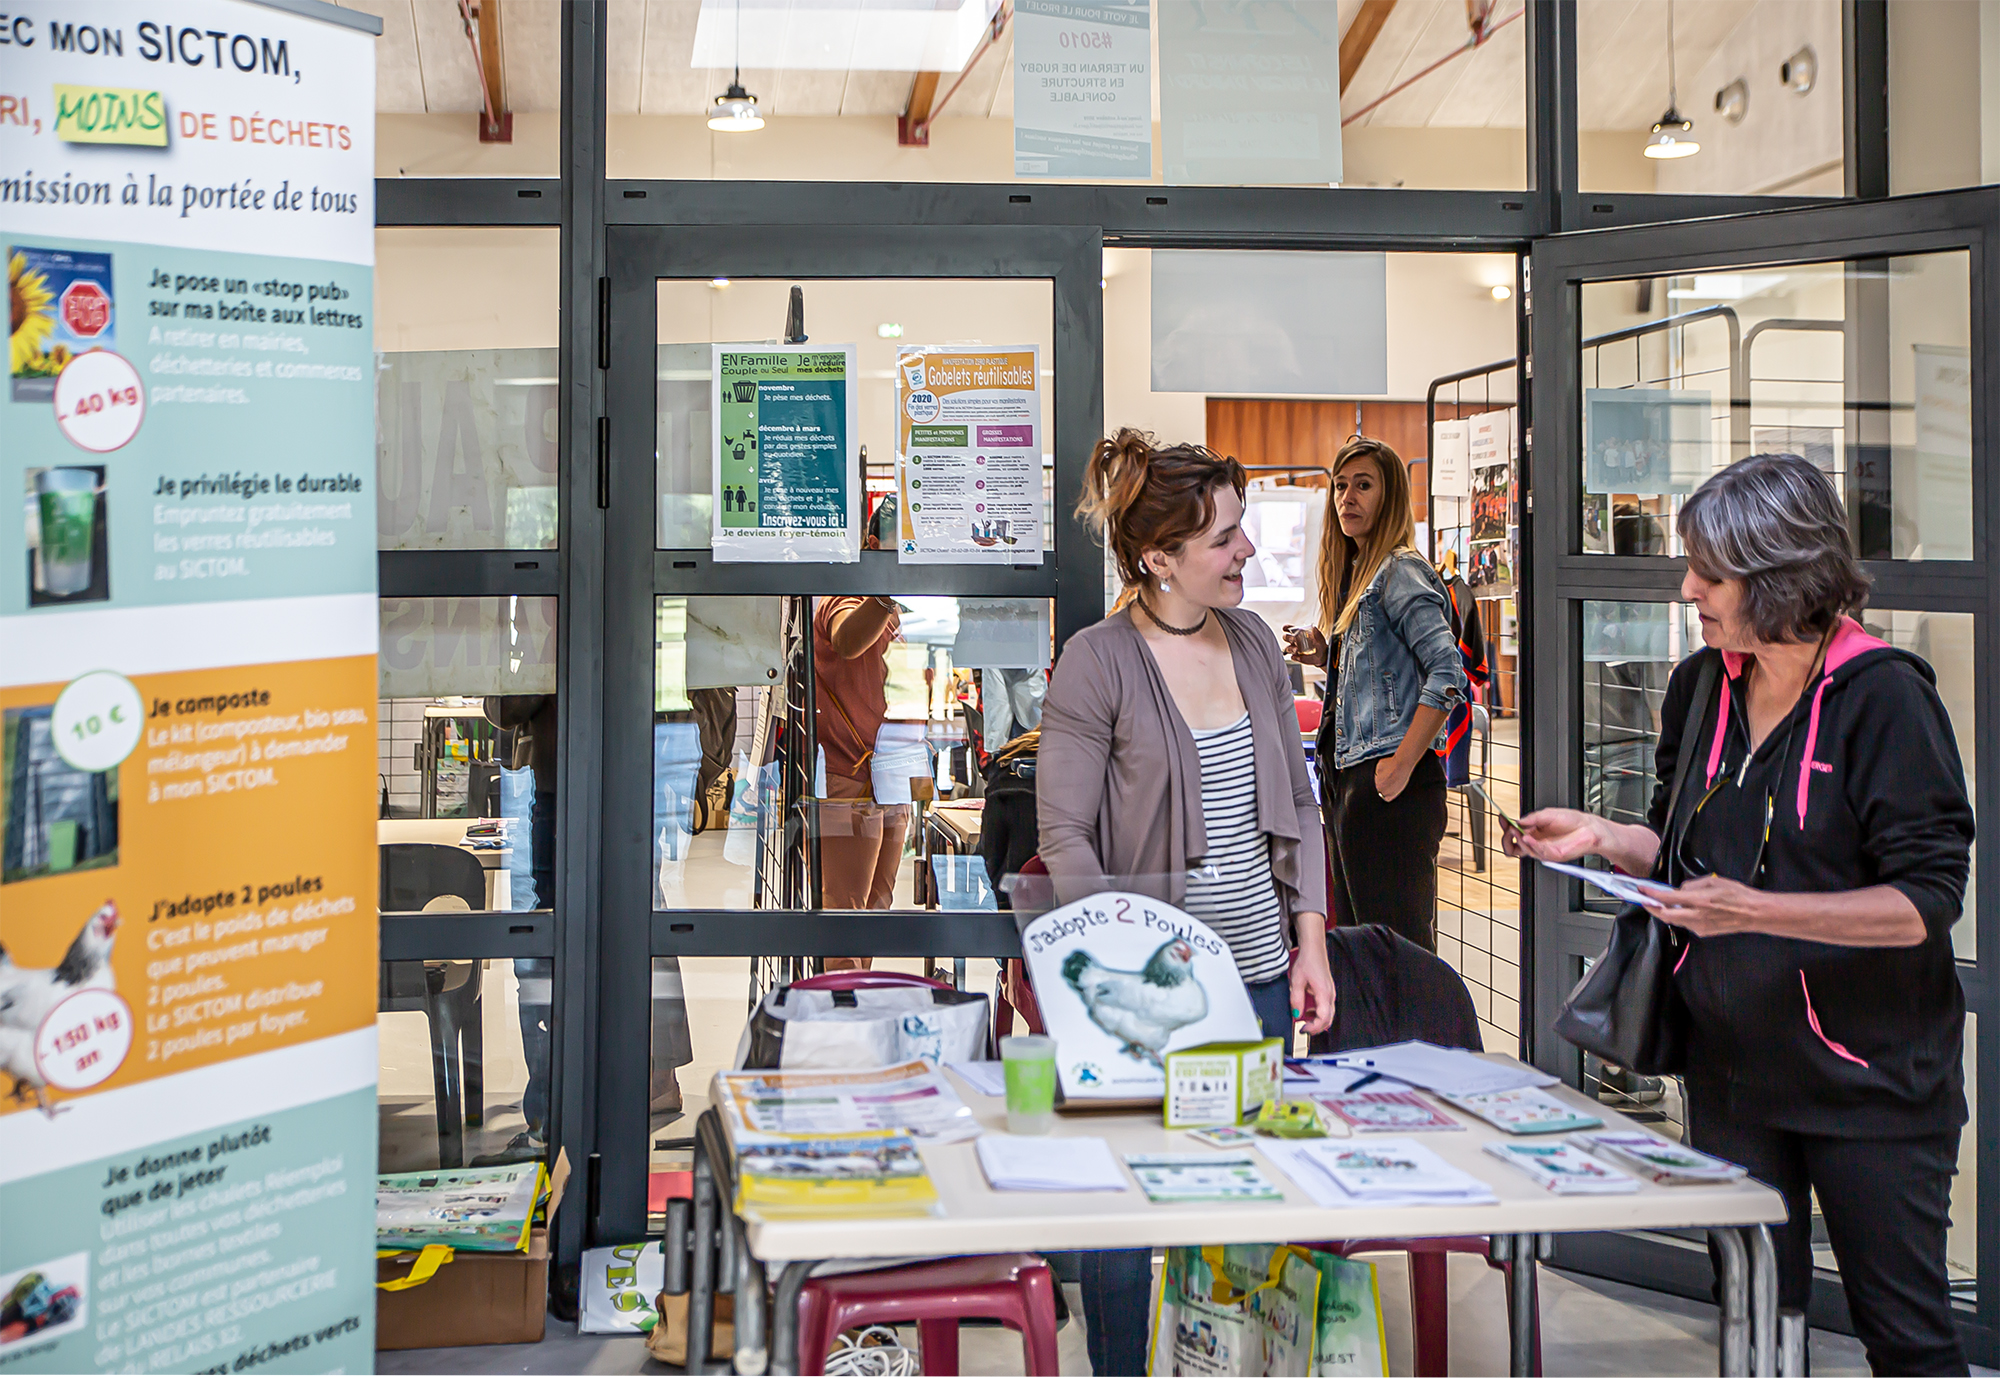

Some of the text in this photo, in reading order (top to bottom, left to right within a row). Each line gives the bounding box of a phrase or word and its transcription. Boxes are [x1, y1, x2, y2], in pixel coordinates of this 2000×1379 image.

[50, 21, 124, 57] MON
[137, 21, 302, 85] SICTOM,
[54, 91, 165, 133] MOINS
[179, 111, 219, 141] DE
[230, 111, 352, 151] DÉCHETS
[121, 173, 139, 205] à
[149, 174, 174, 207] la
[179, 179, 266, 218] portée
[273, 180, 304, 211] de
[311, 187, 358, 214] tous
[148, 268, 349, 303] Je pose un «stop pub»
[148, 300, 362, 329] sur ma boîte aux lettres
[164, 327, 216, 348] retirer
[218, 334, 240, 348] en
[149, 352, 362, 381] déchetteries et commerces
[721, 367, 758, 376] Couple
[722, 355, 810, 366] EN Famille Je
[928, 366, 971, 386] Gobelets
[973, 366, 1032, 385] réutilisables
[74, 385, 139, 417] 40 kg
[773, 394, 788, 402] pèse
[912, 394, 932, 403] 2020
[790, 443, 811, 451] gestes
[812, 443, 837, 451] simples
[154, 472, 362, 500] Je privilégie le durable
[153, 502, 352, 528] Empruntez gratuitement
[763, 513, 838, 526] Inscrivez-vous ici
[154, 526, 336, 552] les verres réutilisables
[780, 529, 845, 538] foyer-témoin
[154, 564, 177, 581] au
[149, 689, 271, 718] Je composte
[70, 704, 126, 741] 10 €
[148, 708, 330, 747] Le kit bio
[250, 740, 261, 761] à
[264, 733, 348, 759] demander
[148, 781, 160, 804] à
[163, 780, 203, 800] mon
[148, 875, 323, 922] J'adopte 2 poules
[194, 897, 356, 941] le poids de déchets
[1029, 898, 1223, 955] J'adopte 2 Poules
[146, 928, 329, 980] que peuvent manger
[147, 980, 324, 1034] Le SICTOM distribue
[148, 985, 159, 1006] 2
[94, 1012, 119, 1033] kg
[148, 1041, 159, 1061] 2
[162, 1028, 223, 1062] poules
[226, 1021, 258, 1045] par
[76, 1050, 99, 1072] an
[102, 1124, 272, 1188] Je donne plutôt
[101, 1165, 228, 1218] que de jeter
[233, 1315, 360, 1372] déchets verts
